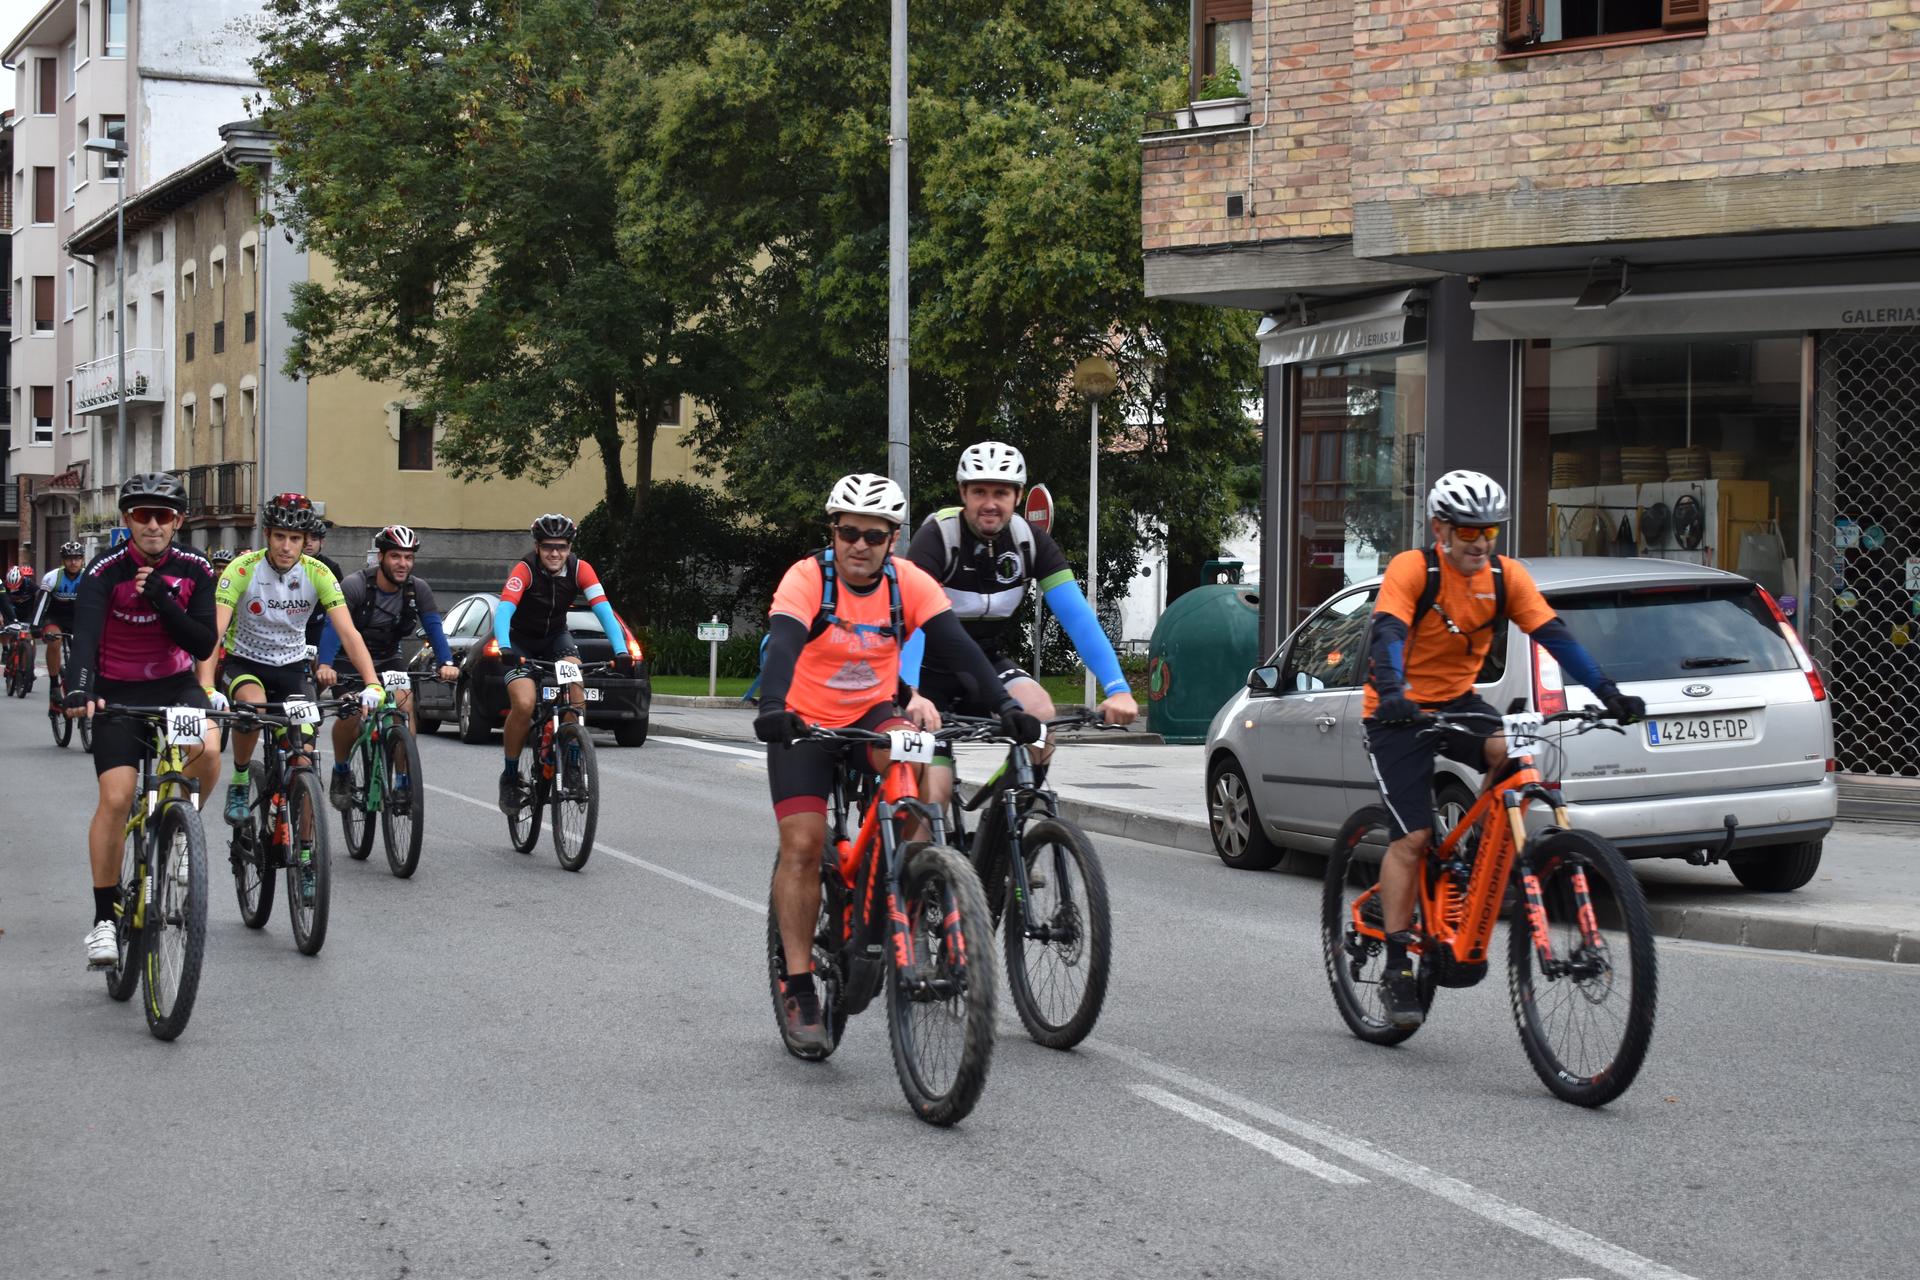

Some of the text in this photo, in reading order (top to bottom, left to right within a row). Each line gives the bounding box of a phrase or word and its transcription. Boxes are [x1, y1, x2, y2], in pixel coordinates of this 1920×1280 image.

[173, 715, 200, 737] 480
[1662, 718, 1748, 741] 4249 FDP
